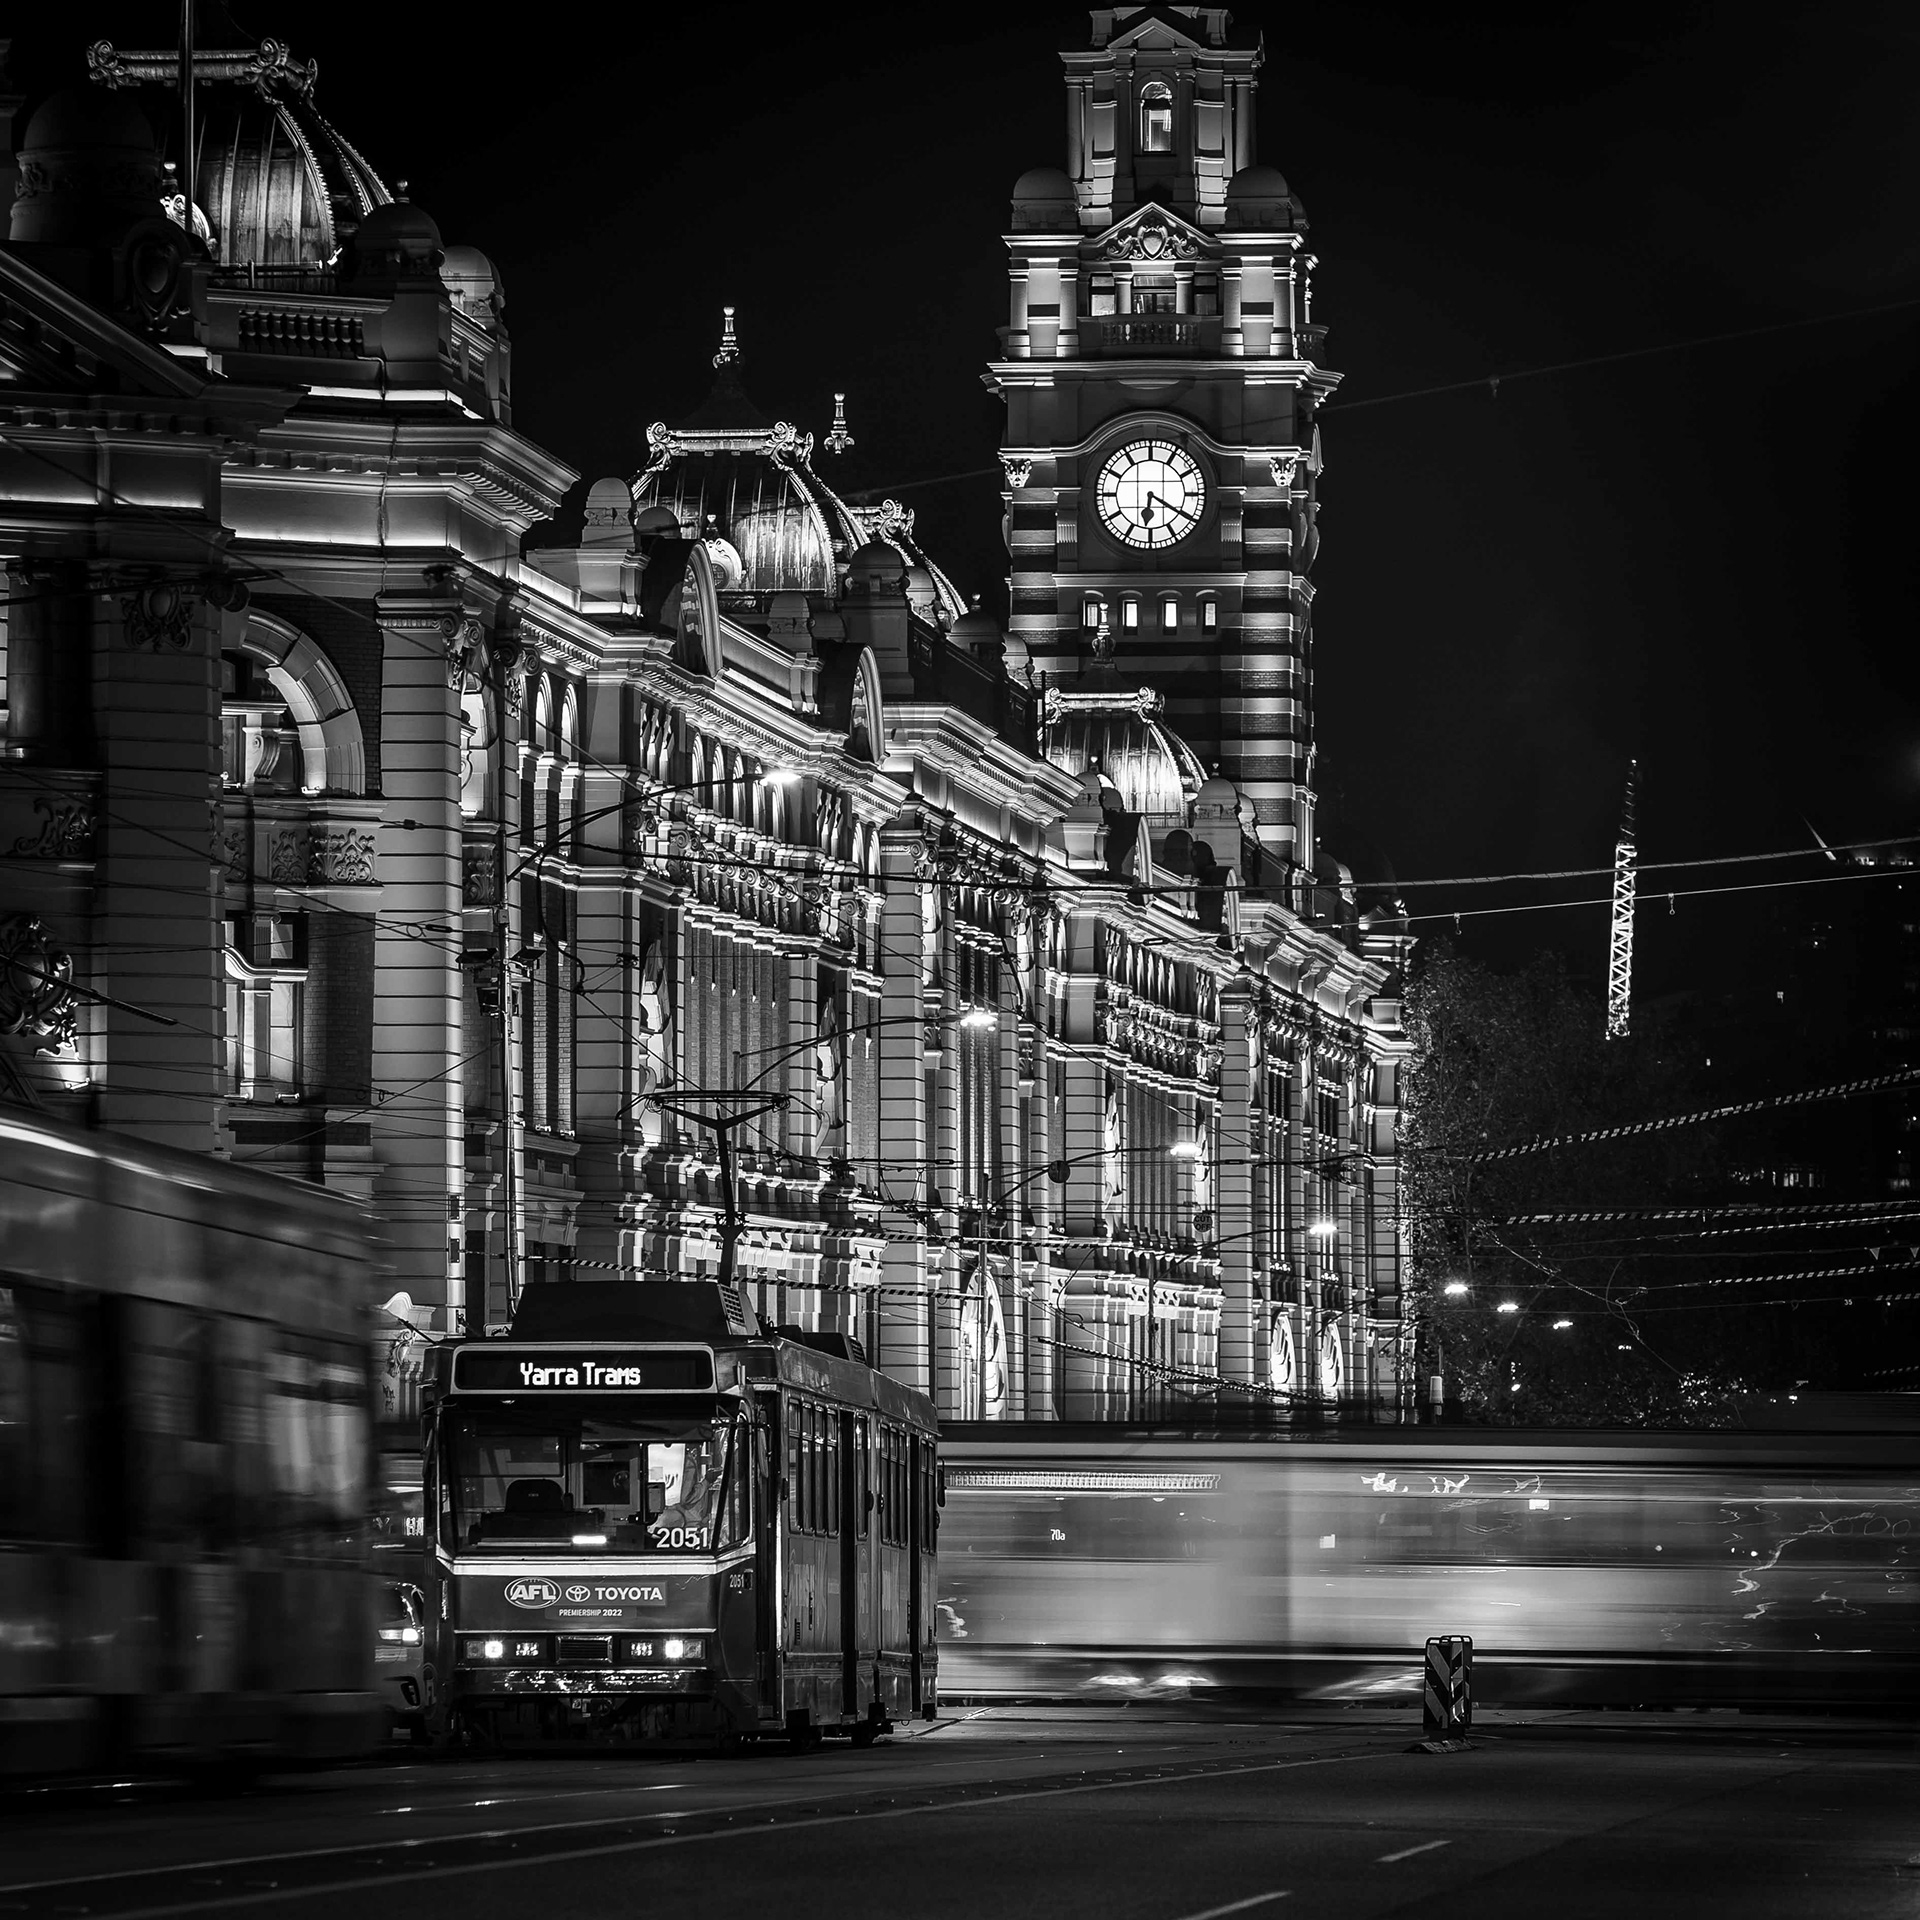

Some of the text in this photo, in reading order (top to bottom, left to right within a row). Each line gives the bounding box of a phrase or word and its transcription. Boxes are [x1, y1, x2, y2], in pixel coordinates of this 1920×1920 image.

[520, 1361, 641, 1386] Yarra Trams
[656, 1527, 708, 1549] 2051
[1050, 1528, 1066, 1541] 70a
[729, 1574, 745, 1588] 2051
[510, 1584, 557, 1601] AFL
[594, 1587, 663, 1601] TOYOTA
[558, 1608, 623, 1617] PREMIERSHIP 2022
